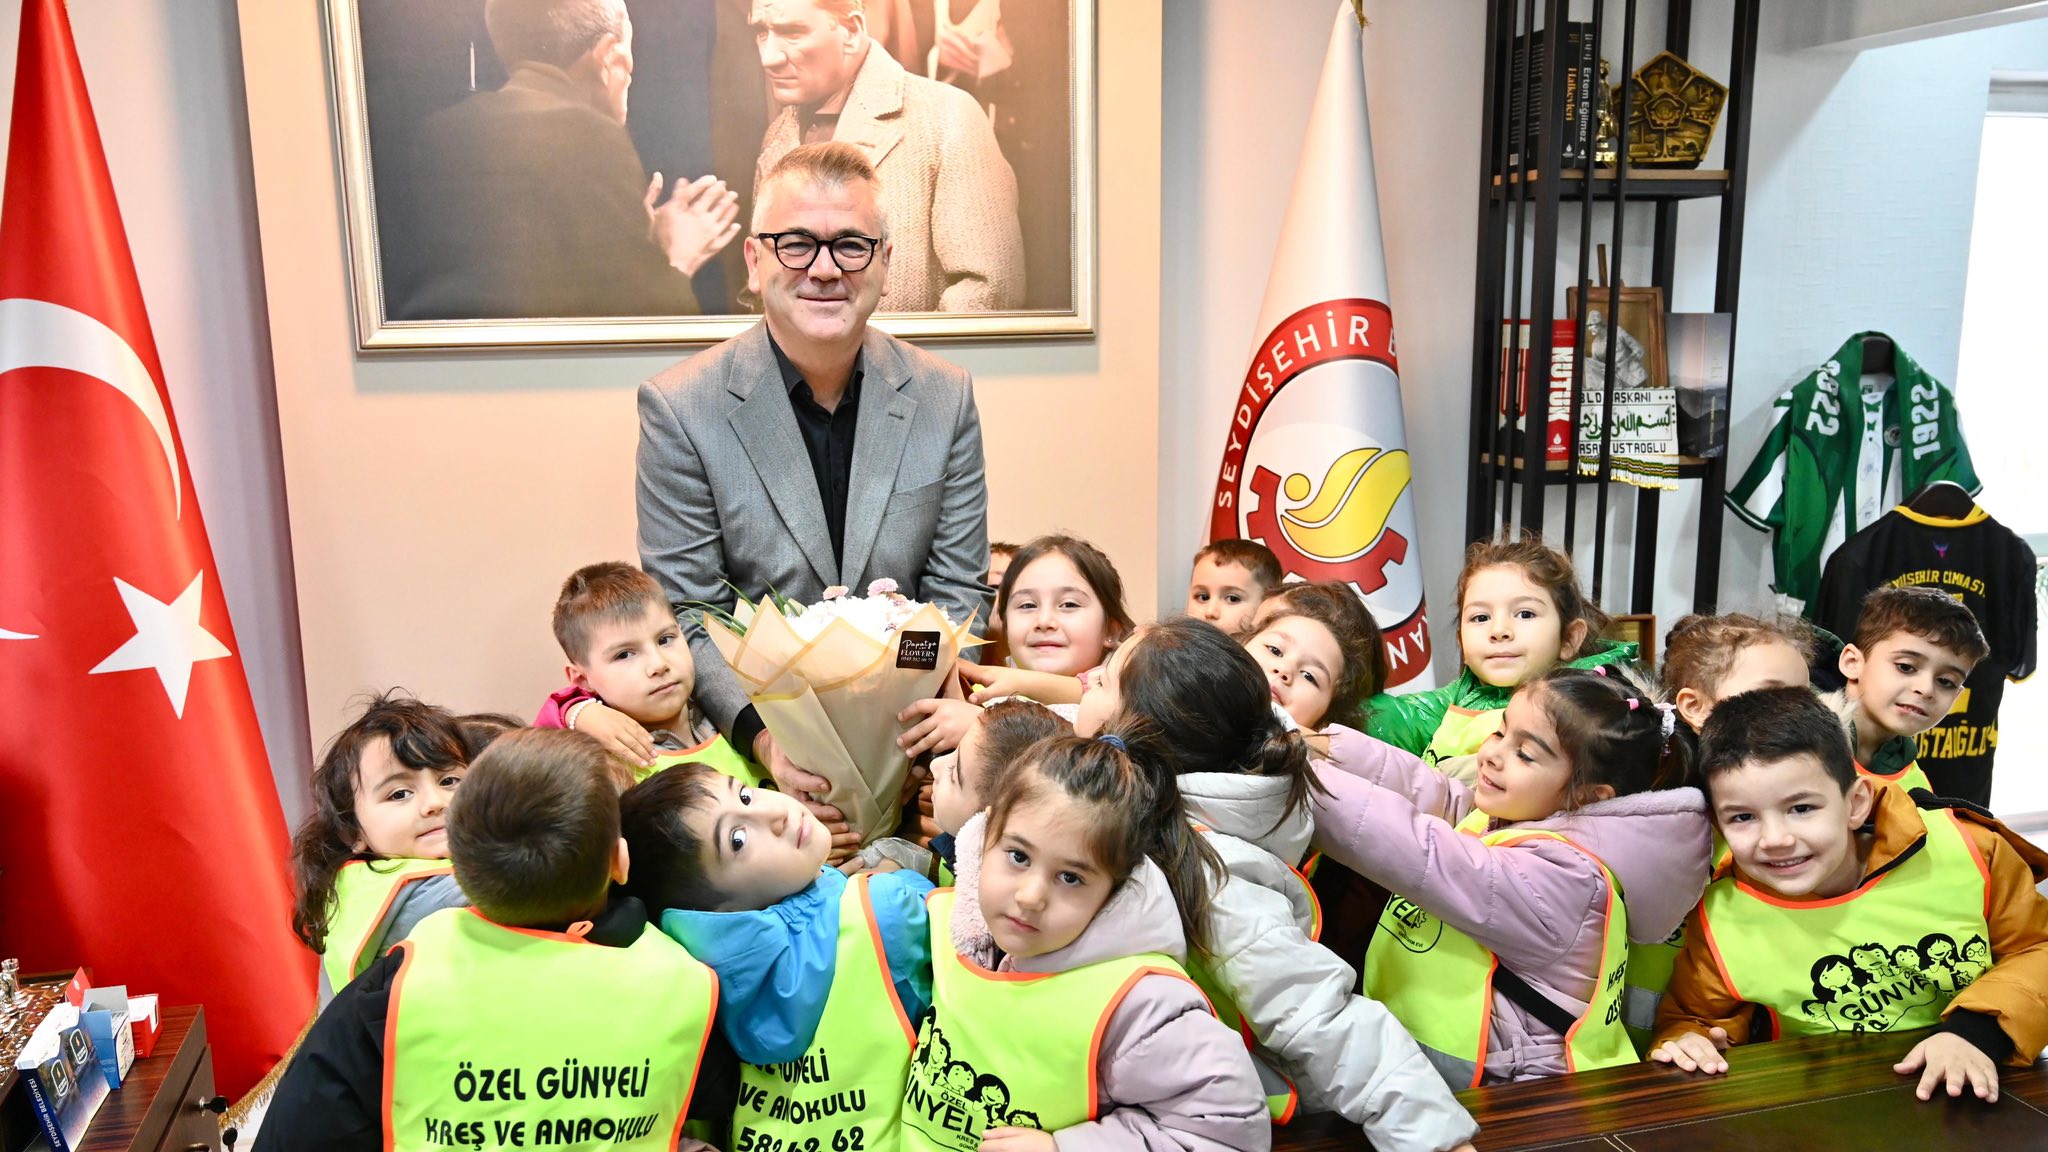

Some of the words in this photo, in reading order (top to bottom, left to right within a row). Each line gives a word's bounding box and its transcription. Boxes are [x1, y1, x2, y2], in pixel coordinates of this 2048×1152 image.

[1548, 346, 1574, 422] NUTUK
[1217, 310, 1370, 509] SEYDİŞEHİR
[1911, 380, 1940, 460] 1922
[900, 649, 935, 657] FLOWERS
[453, 1060, 527, 1103] ÖZEL
[536, 1057, 651, 1100] GÜNYELİ
[739, 1081, 769, 1113] VE
[941, 1089, 968, 1111] ÖZEL
[425, 1117, 486, 1151] KREŞ
[494, 1120, 526, 1147] VE
[535, 1113, 660, 1146] ANAOKULU
[831, 1126, 865, 1152] 62
